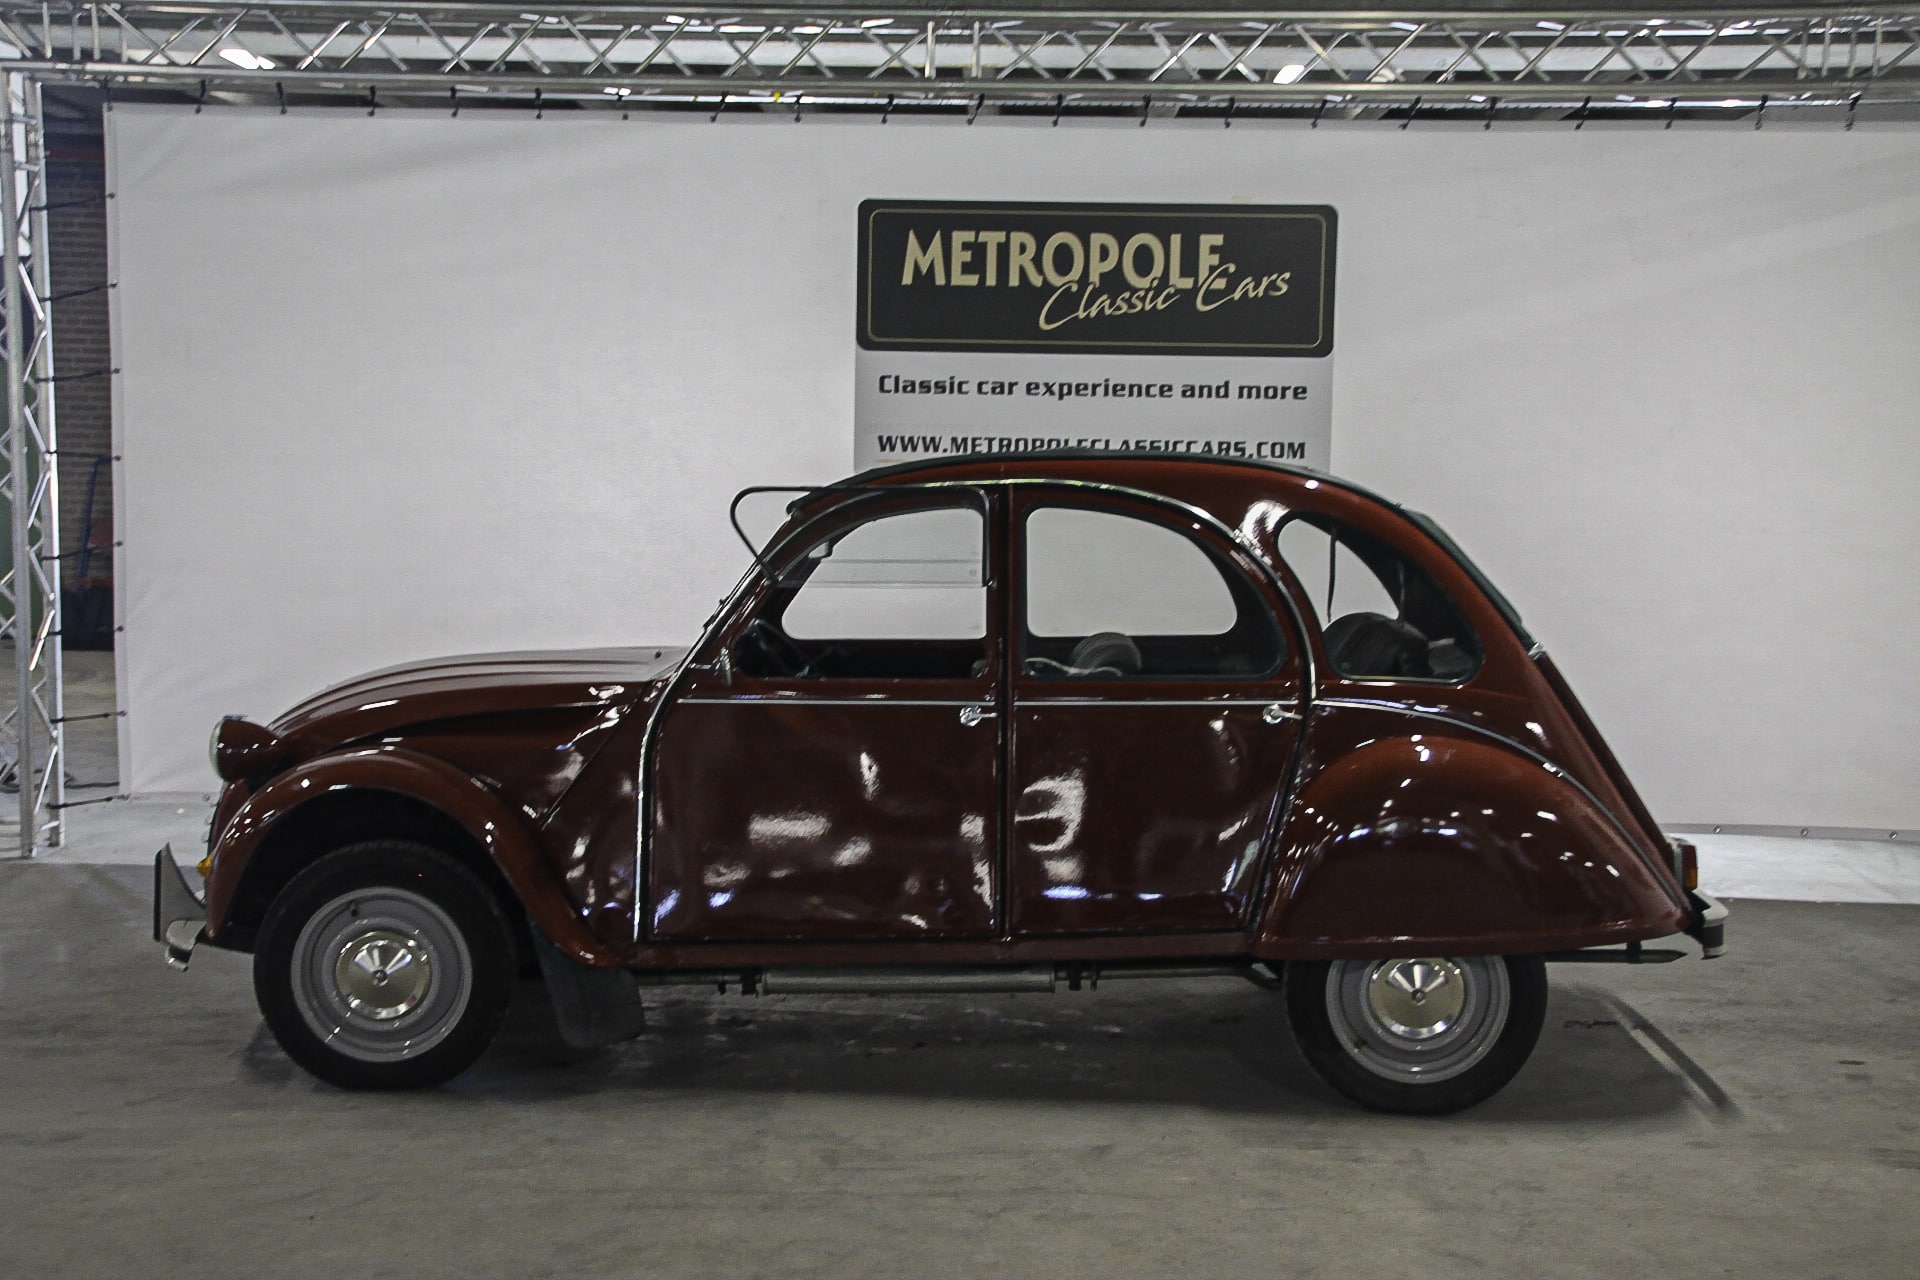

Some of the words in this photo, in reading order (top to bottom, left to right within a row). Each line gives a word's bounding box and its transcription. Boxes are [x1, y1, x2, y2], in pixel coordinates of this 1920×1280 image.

[901, 229, 1225, 290] METROPOLE
[1038, 280, 1181, 331] Classic
[1195, 262, 1291, 312] Cars
[878, 374, 970, 395] Classic
[976, 380, 1019, 396] car
[1025, 377, 1174, 401] experience
[1180, 380, 1230, 400] and
[1237, 385, 1308, 401] more
